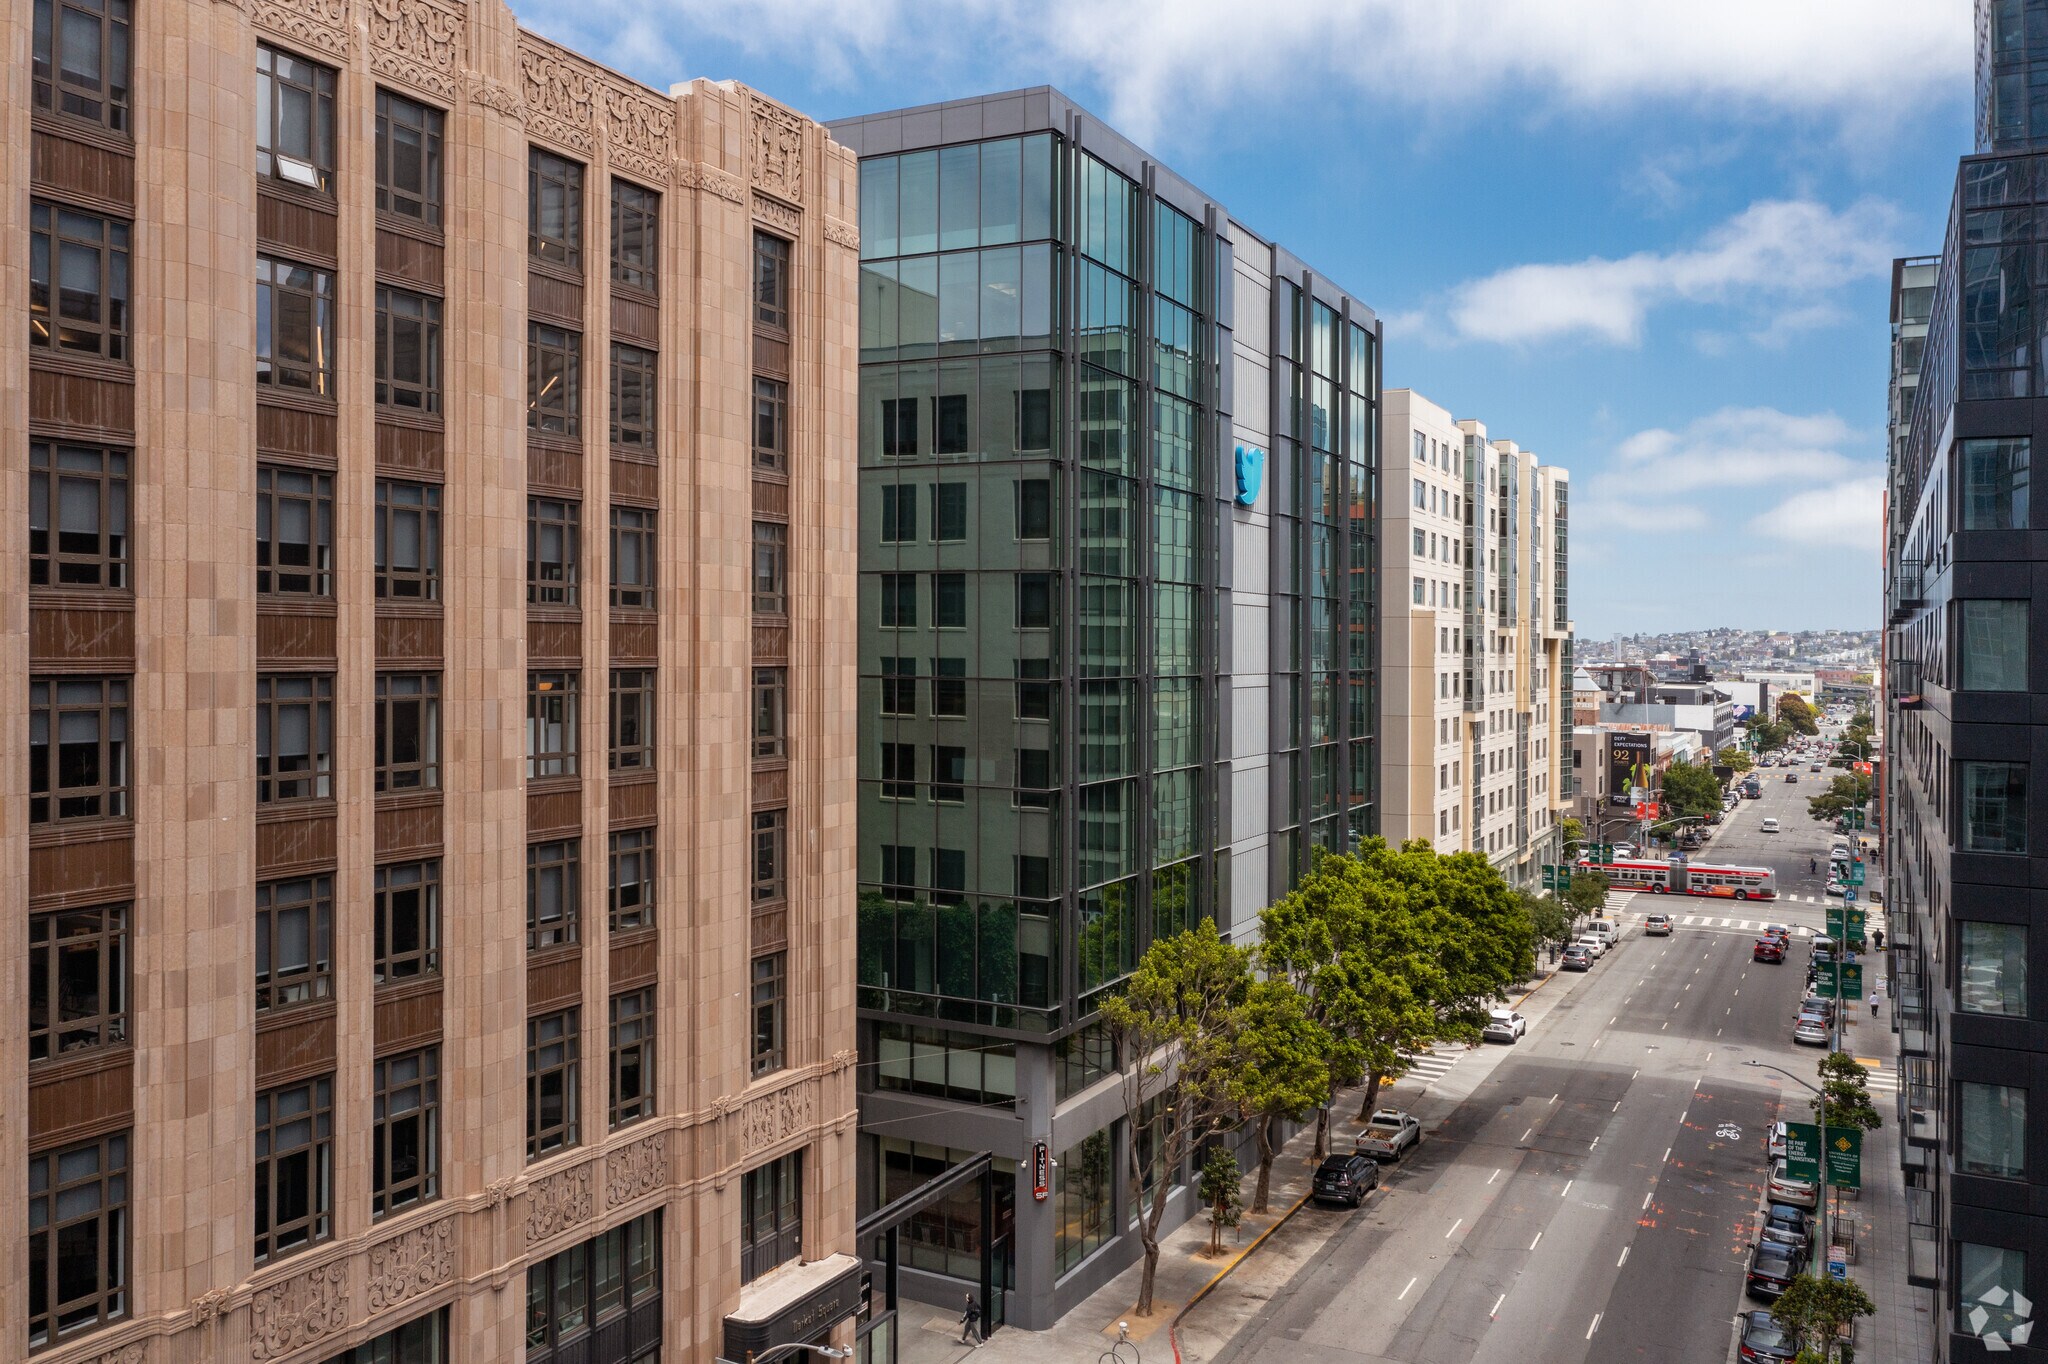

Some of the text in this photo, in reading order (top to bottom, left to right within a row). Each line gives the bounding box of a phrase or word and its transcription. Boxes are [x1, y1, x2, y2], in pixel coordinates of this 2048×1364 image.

[1614, 750, 1629, 760] 92
[793, 1299, 839, 1333] Market Square
